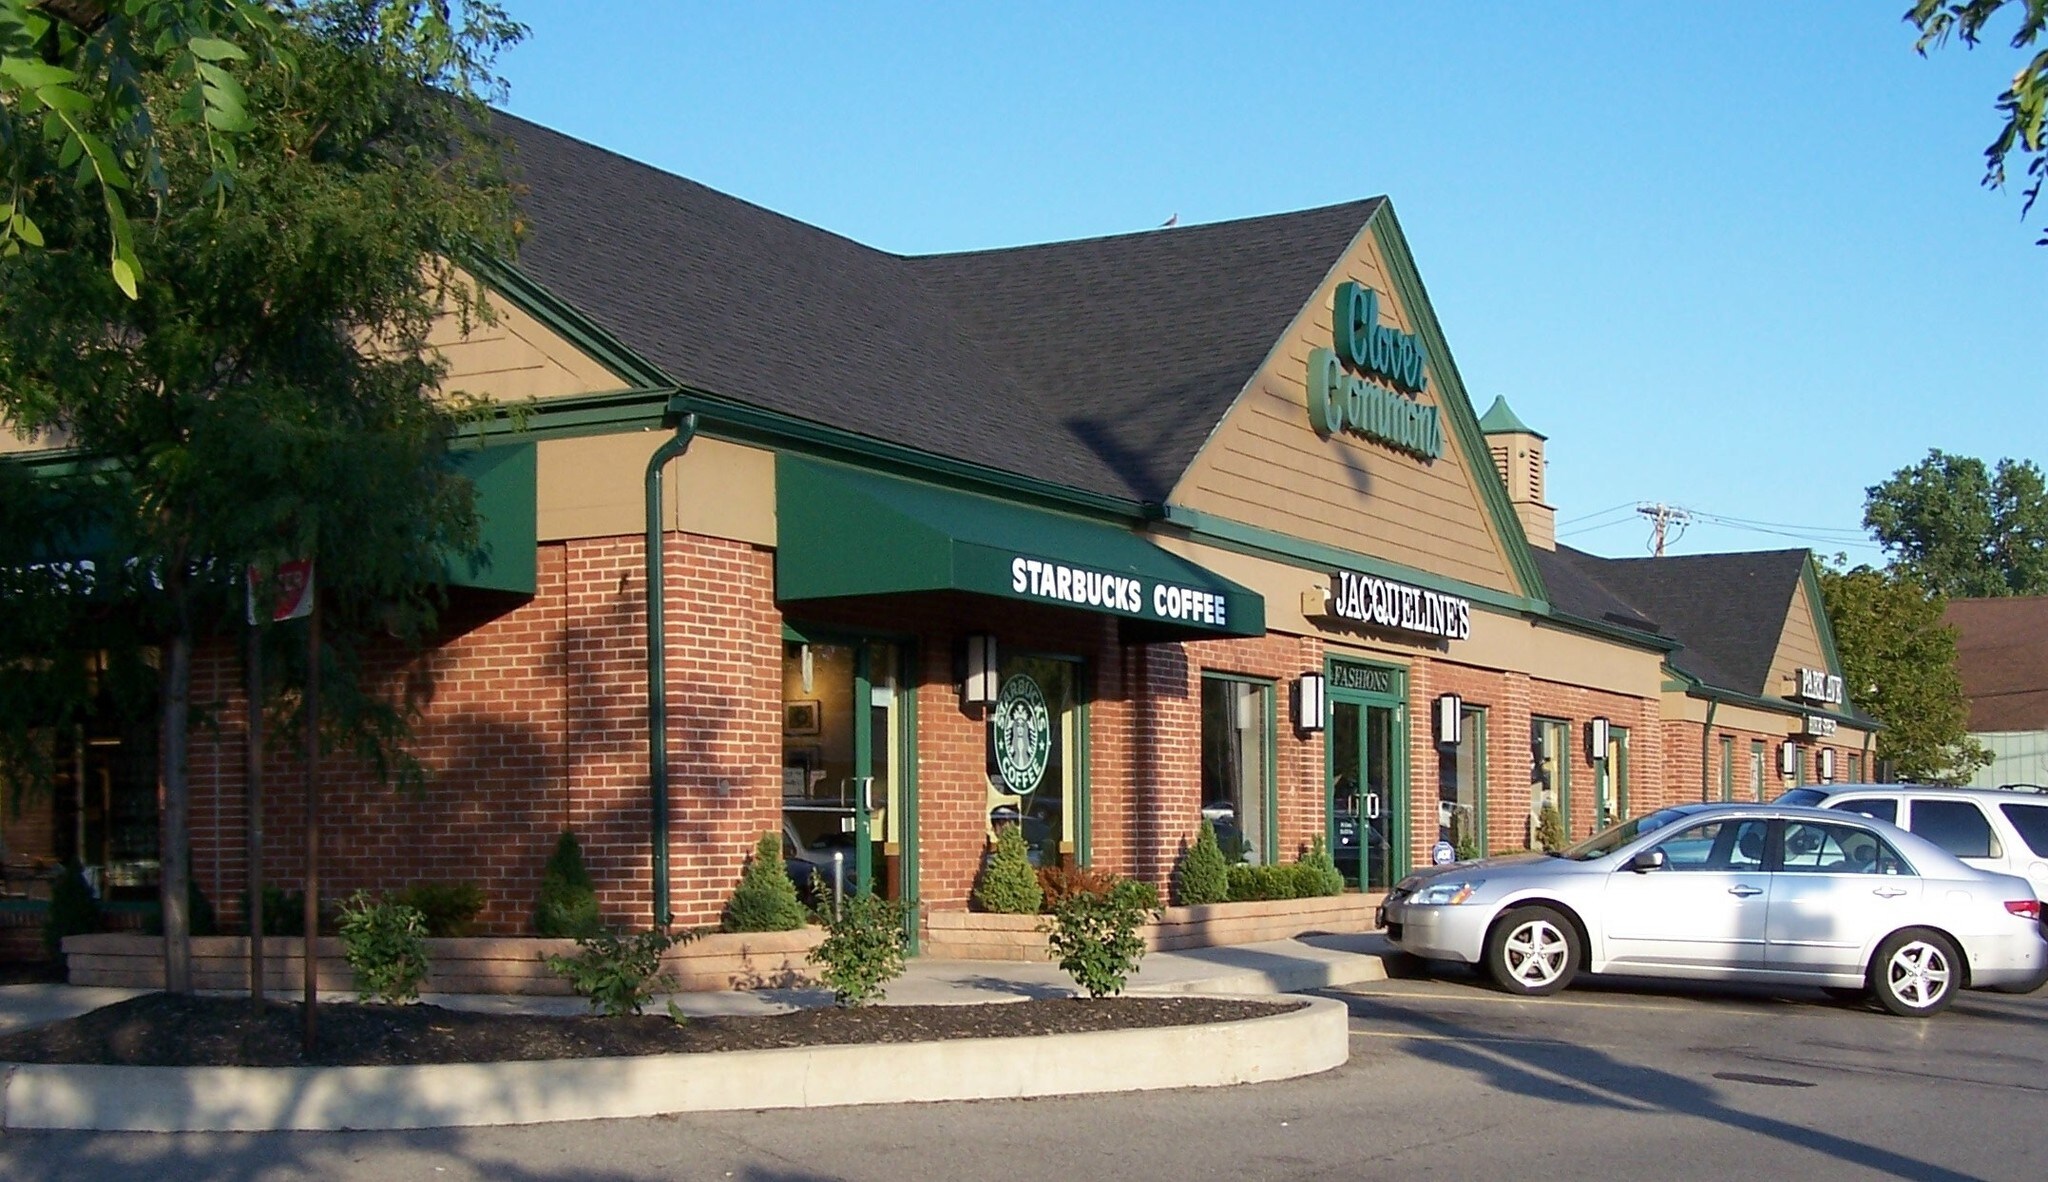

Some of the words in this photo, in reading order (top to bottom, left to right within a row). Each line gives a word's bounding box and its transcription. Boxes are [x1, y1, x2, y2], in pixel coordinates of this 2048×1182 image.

[1340, 282, 1428, 392] Clover
[1314, 348, 1443, 459] Commons
[1012, 557, 1141, 613] STARBUCKS
[1153, 584, 1226, 626] COFFEE
[1335, 571, 1470, 641] JACQUELINE'S
[998, 679, 1046, 732] STARBUCKS
[1333, 665, 1389, 692] FASHIONS
[1802, 667, 1826, 701] PARK
[1001, 756, 1041, 788] COFFEE
